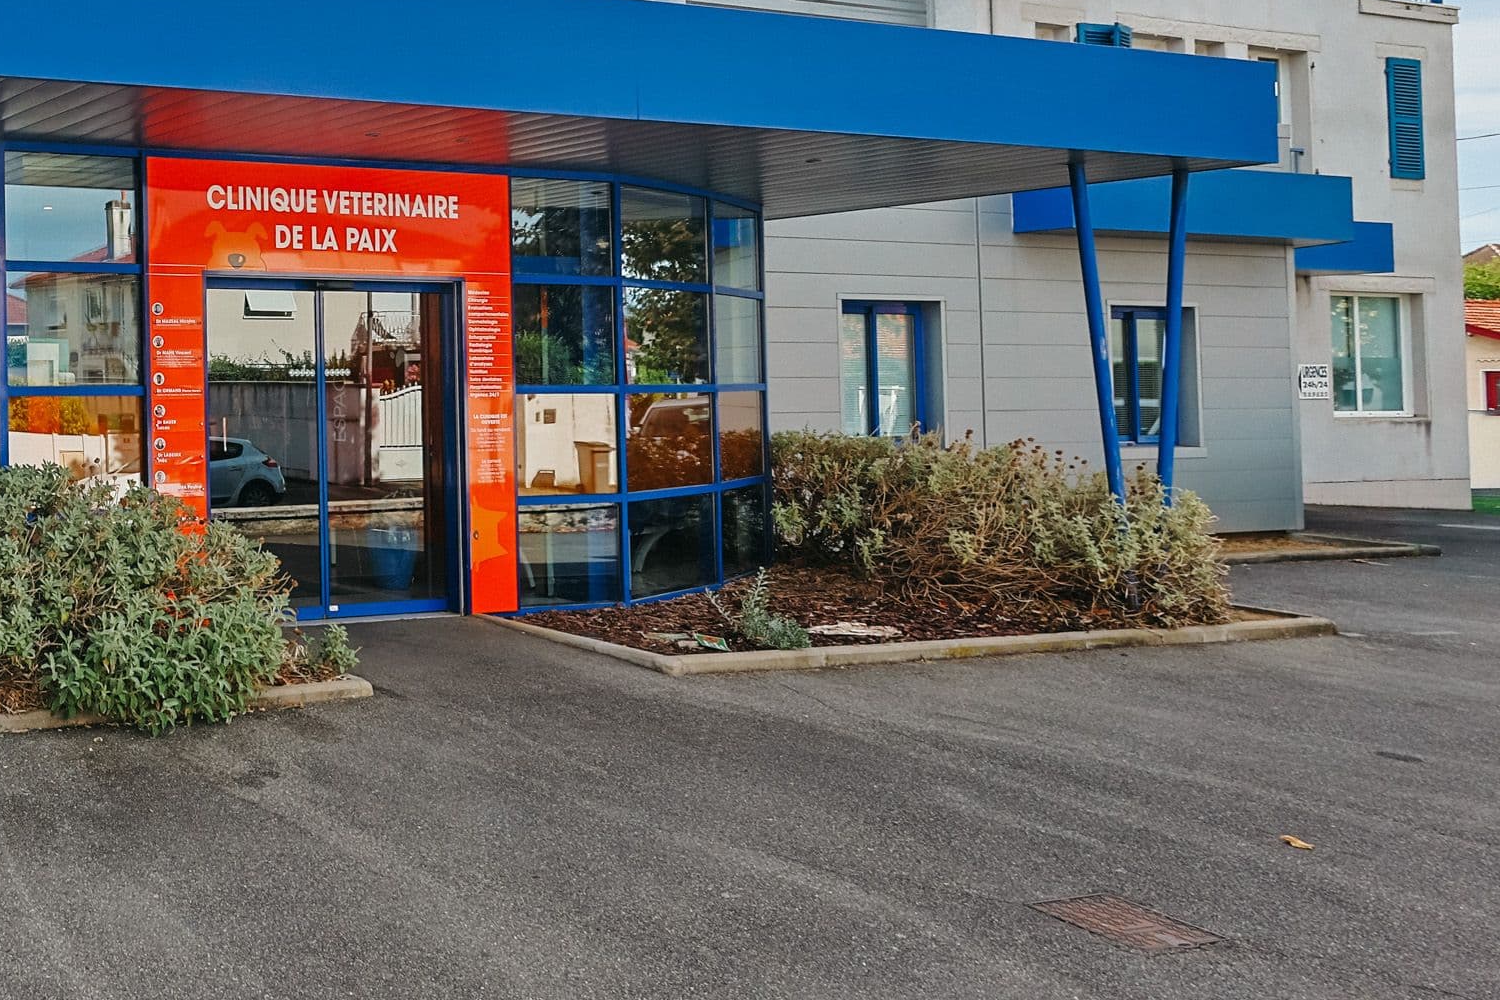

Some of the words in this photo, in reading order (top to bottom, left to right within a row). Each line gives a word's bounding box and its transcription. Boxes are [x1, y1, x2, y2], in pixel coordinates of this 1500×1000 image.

[206, 184, 318, 214] CLINIQUE
[322, 189, 459, 219] VETERINAIRE
[275, 224, 304, 250] DE
[311, 225, 339, 251] LA
[346, 227, 398, 253] PAIX
